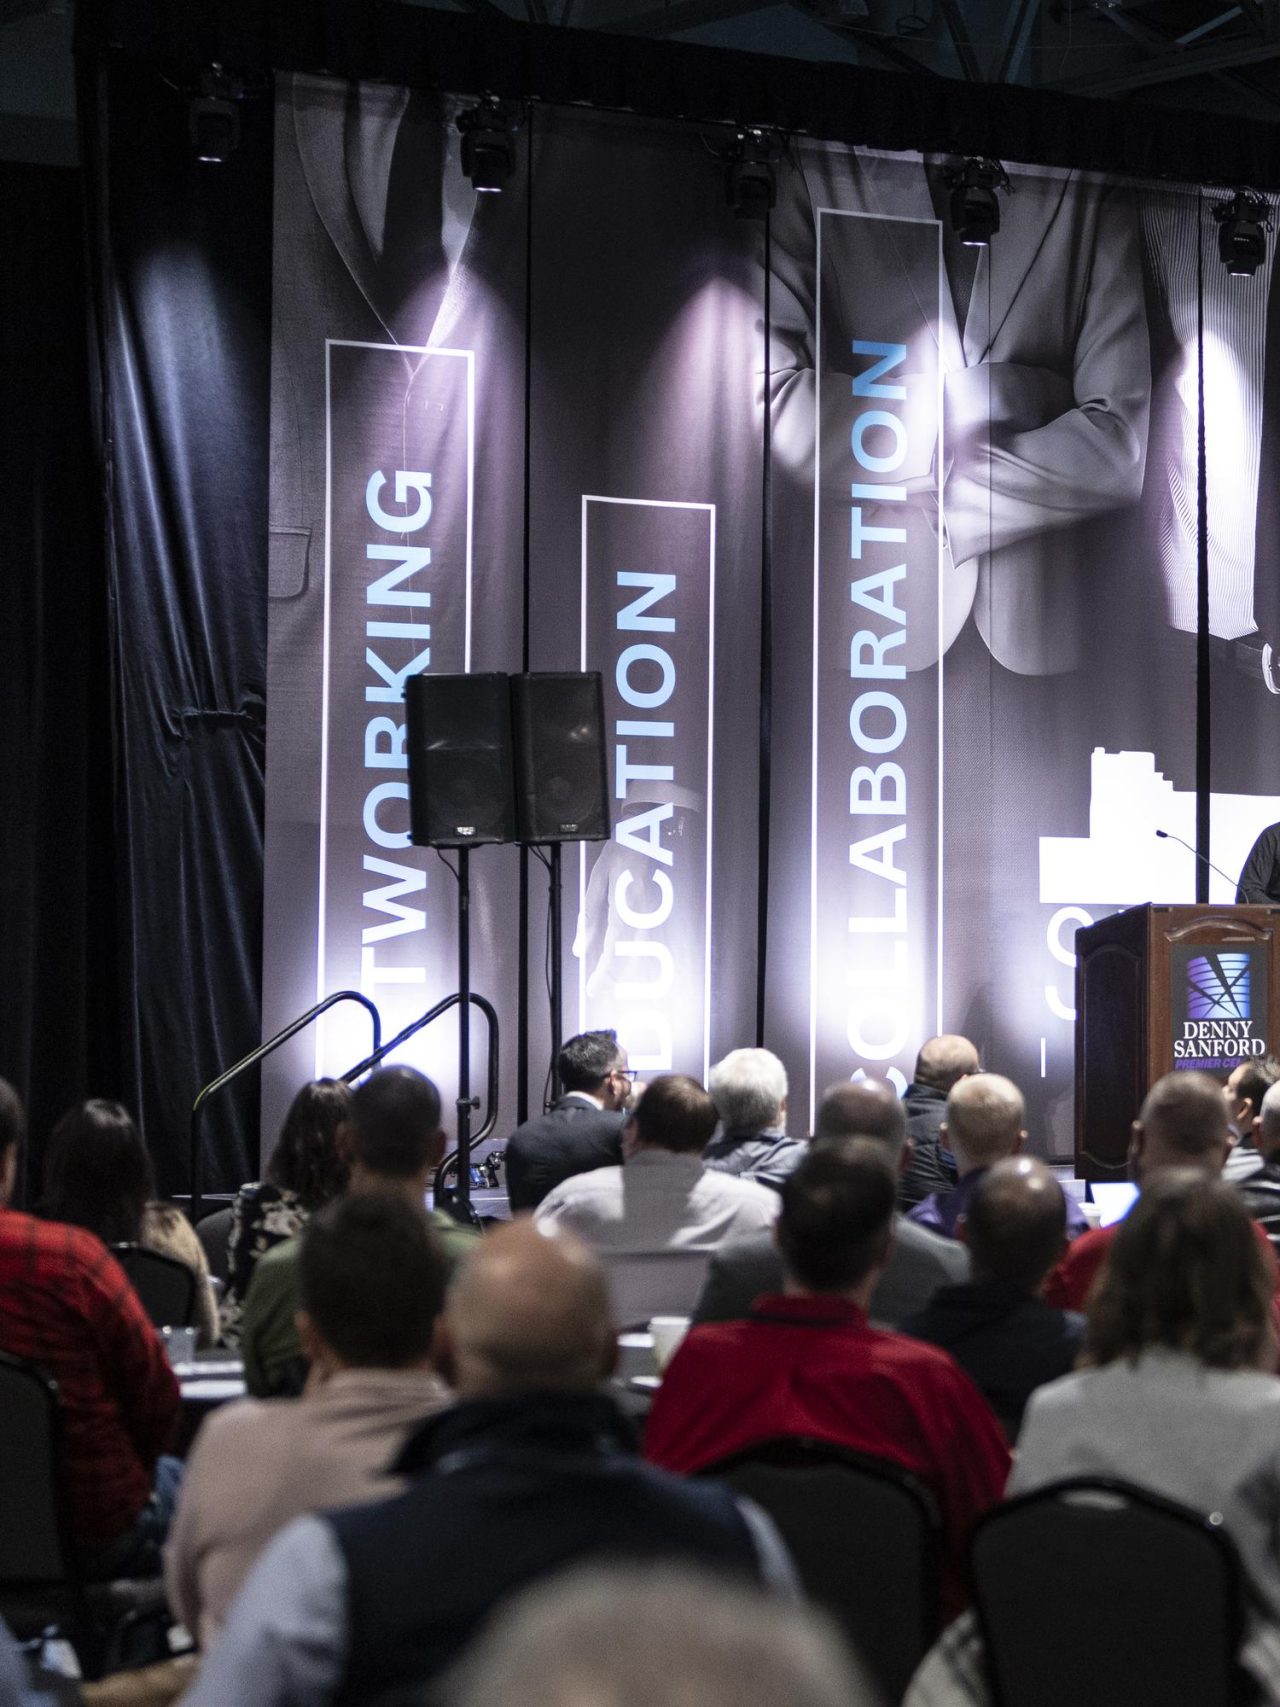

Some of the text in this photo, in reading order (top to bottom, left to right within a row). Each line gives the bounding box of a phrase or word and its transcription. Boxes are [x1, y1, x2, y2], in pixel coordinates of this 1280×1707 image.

[360, 468, 433, 1004] TWORKING
[614, 570, 677, 1072] DUCATION
[1183, 1021, 1253, 1039] DENNY
[1174, 1039, 1266, 1058] SANFORD
[1175, 1057, 1221, 1071] PREMIER
